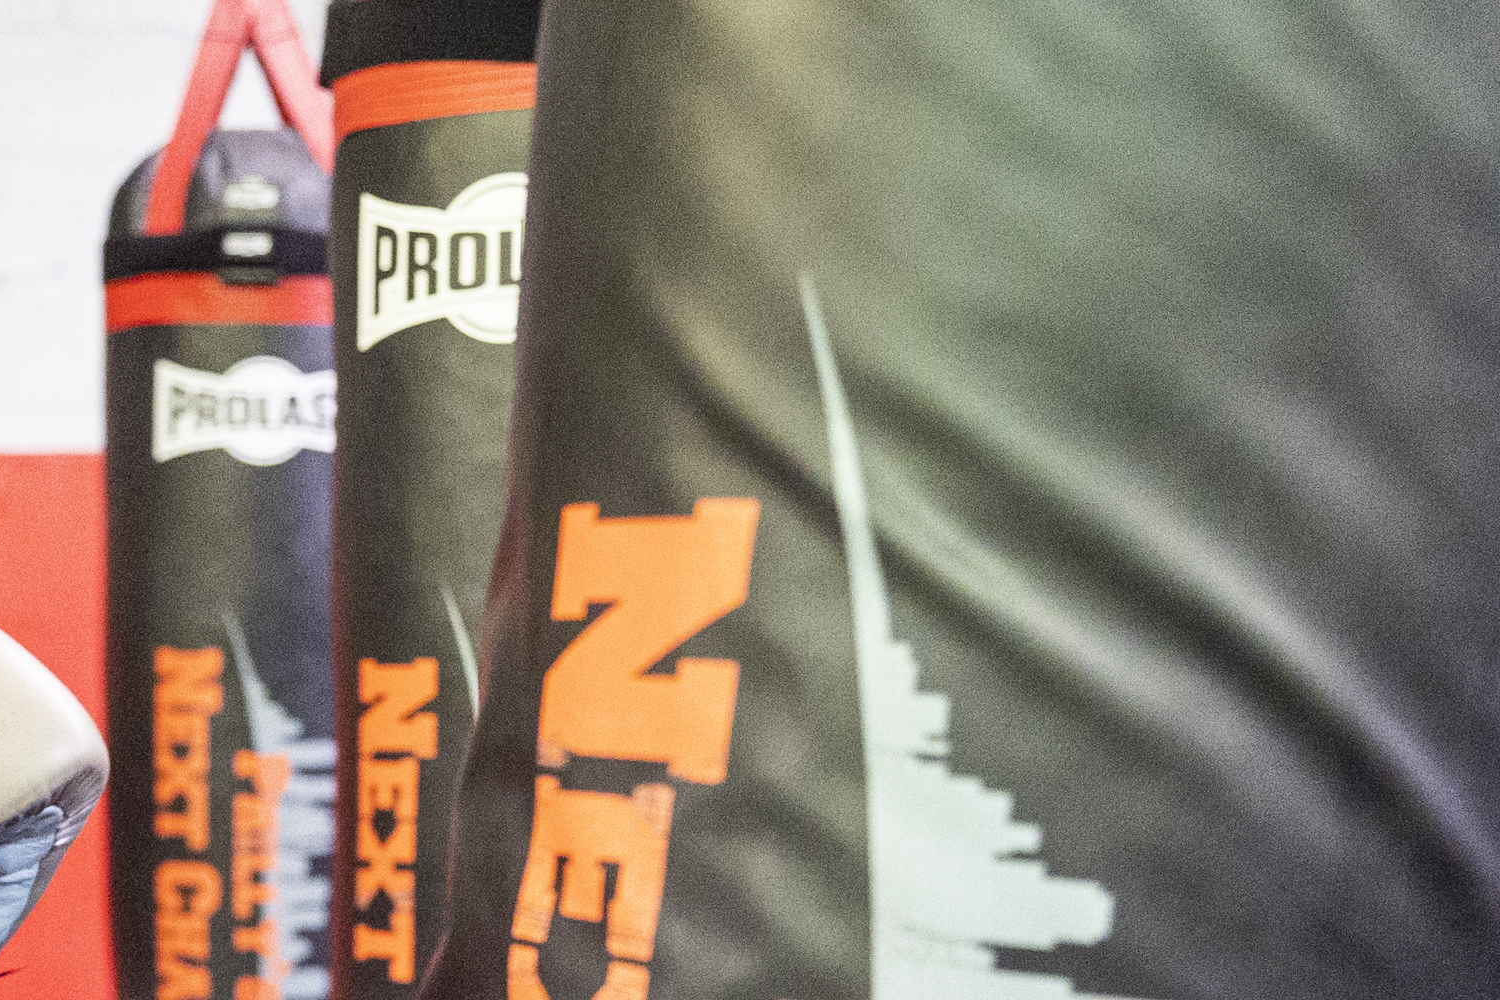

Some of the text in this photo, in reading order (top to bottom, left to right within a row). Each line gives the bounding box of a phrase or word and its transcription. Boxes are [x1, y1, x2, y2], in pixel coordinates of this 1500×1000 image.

[375, 224, 521, 317] PROL
[154, 645, 224, 851] NEXT
[352, 656, 439, 984] NEXT
